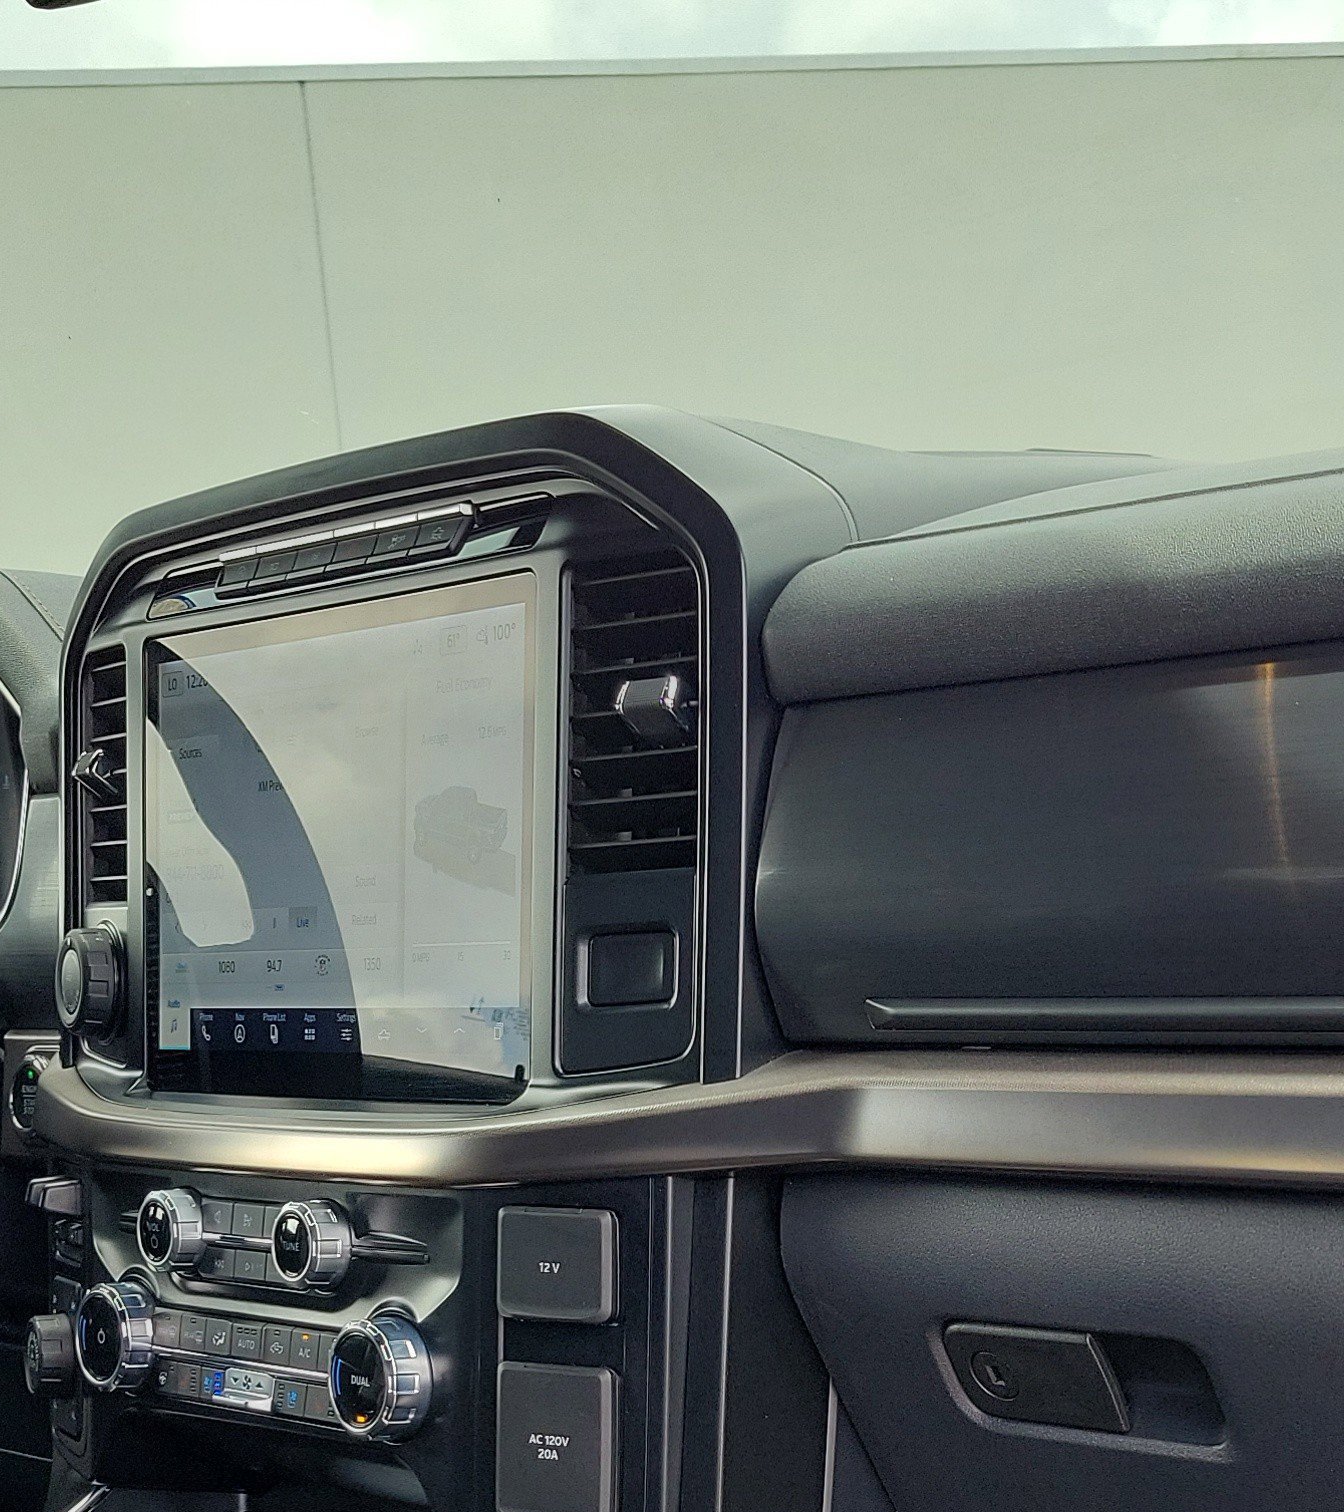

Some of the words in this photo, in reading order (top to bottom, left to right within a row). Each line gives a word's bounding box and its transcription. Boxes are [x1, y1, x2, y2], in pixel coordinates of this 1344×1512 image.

[539, 1262, 551, 1274] 12
[237, 1338, 255, 1350] AUTO
[298, 1346, 311, 1359] A/C
[350, 1374, 372, 1388] DUAL
[528, 1433, 543, 1445] AC
[545, 1434, 570, 1448] 120V
[537, 1448, 559, 1461] 20A
